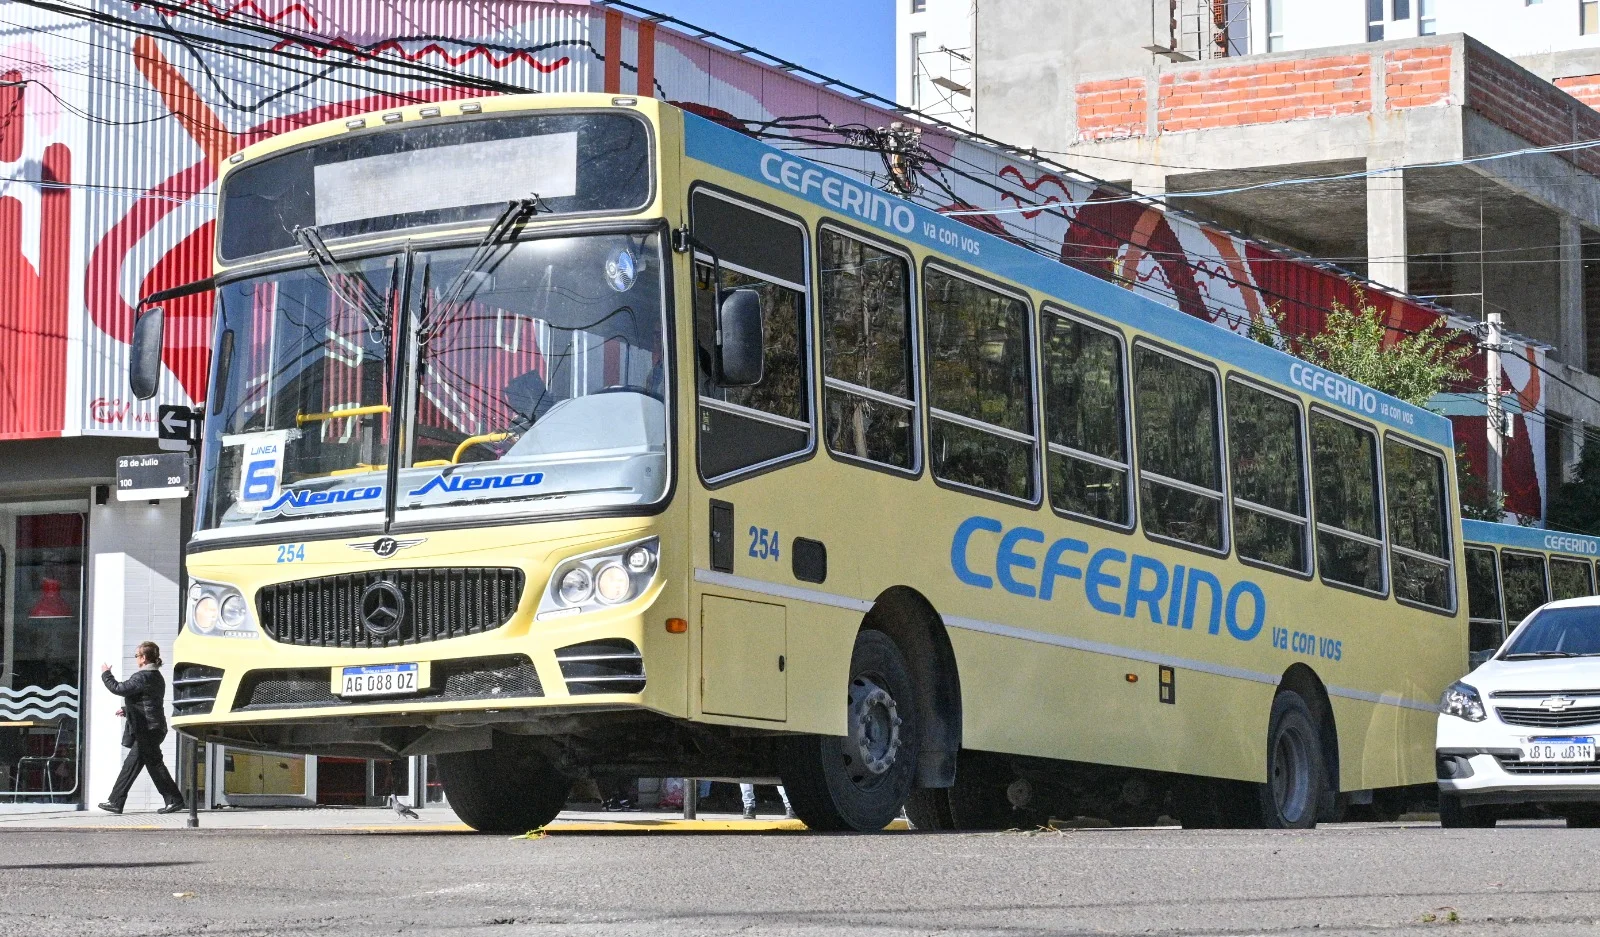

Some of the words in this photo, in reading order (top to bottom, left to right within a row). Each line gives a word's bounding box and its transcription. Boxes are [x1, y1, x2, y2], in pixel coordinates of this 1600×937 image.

[761, 153, 915, 233] CEFERINO
[923, 221, 936, 239] va
[939, 228, 958, 247] con
[961, 235, 980, 255] vos
[1290, 363, 1376, 414] CEFERINO
[1381, 403, 1389, 415] va
[1390, 407, 1401, 420] con
[1402, 411, 1414, 425] vos
[119, 460, 128, 468] 28
[129, 459, 139, 467] de
[140, 458, 159, 467] Julio
[120, 479, 133, 487] 100
[167, 476, 181, 485] 200
[243, 460, 276, 502] 6
[408, 472, 544, 496] Alenco
[262, 486, 382, 511] Alenco
[277, 544, 305, 563] 254
[749, 526, 780, 561] 254
[1544, 535, 1597, 554] CEFERINO
[950, 516, 1266, 641] CEFERINO
[1273, 626, 1288, 650] va
[1292, 631, 1315, 655] con
[1320, 636, 1342, 661] vos
[346, 677, 362, 692] AG
